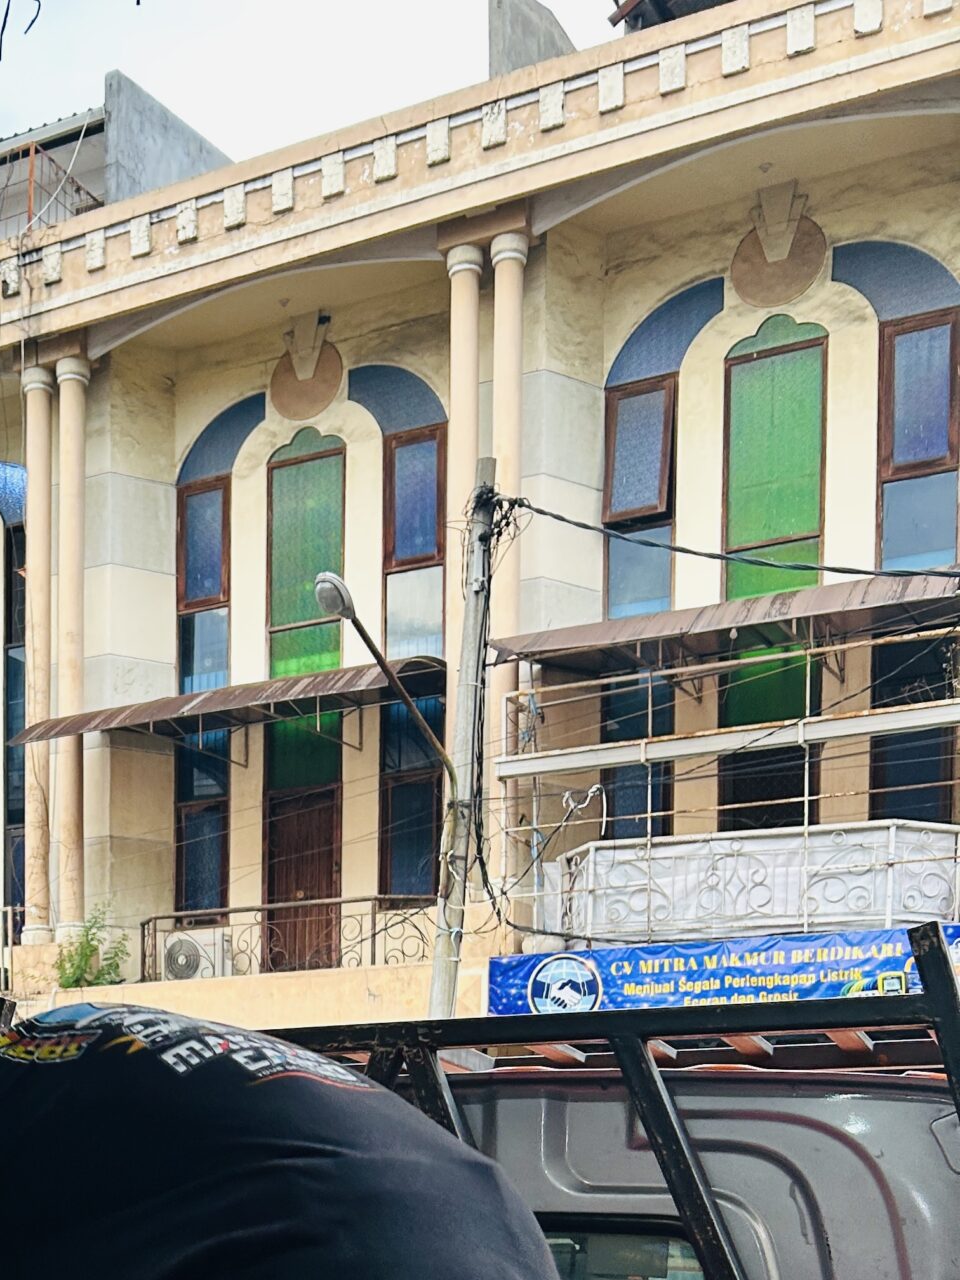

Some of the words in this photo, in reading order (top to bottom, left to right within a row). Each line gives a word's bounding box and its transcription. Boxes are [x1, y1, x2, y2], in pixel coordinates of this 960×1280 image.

[610, 961, 634, 976] CV
[639, 957, 699, 974] MITRA
[704, 951, 784, 969] MAKMUR
[792, 943, 903, 963] BERDIKARI
[624, 981, 674, 996] Menjual
[678, 978, 720, 993] Segala
[725, 973, 815, 988] Perlengkapan
[819, 968, 863, 983] Listrik
